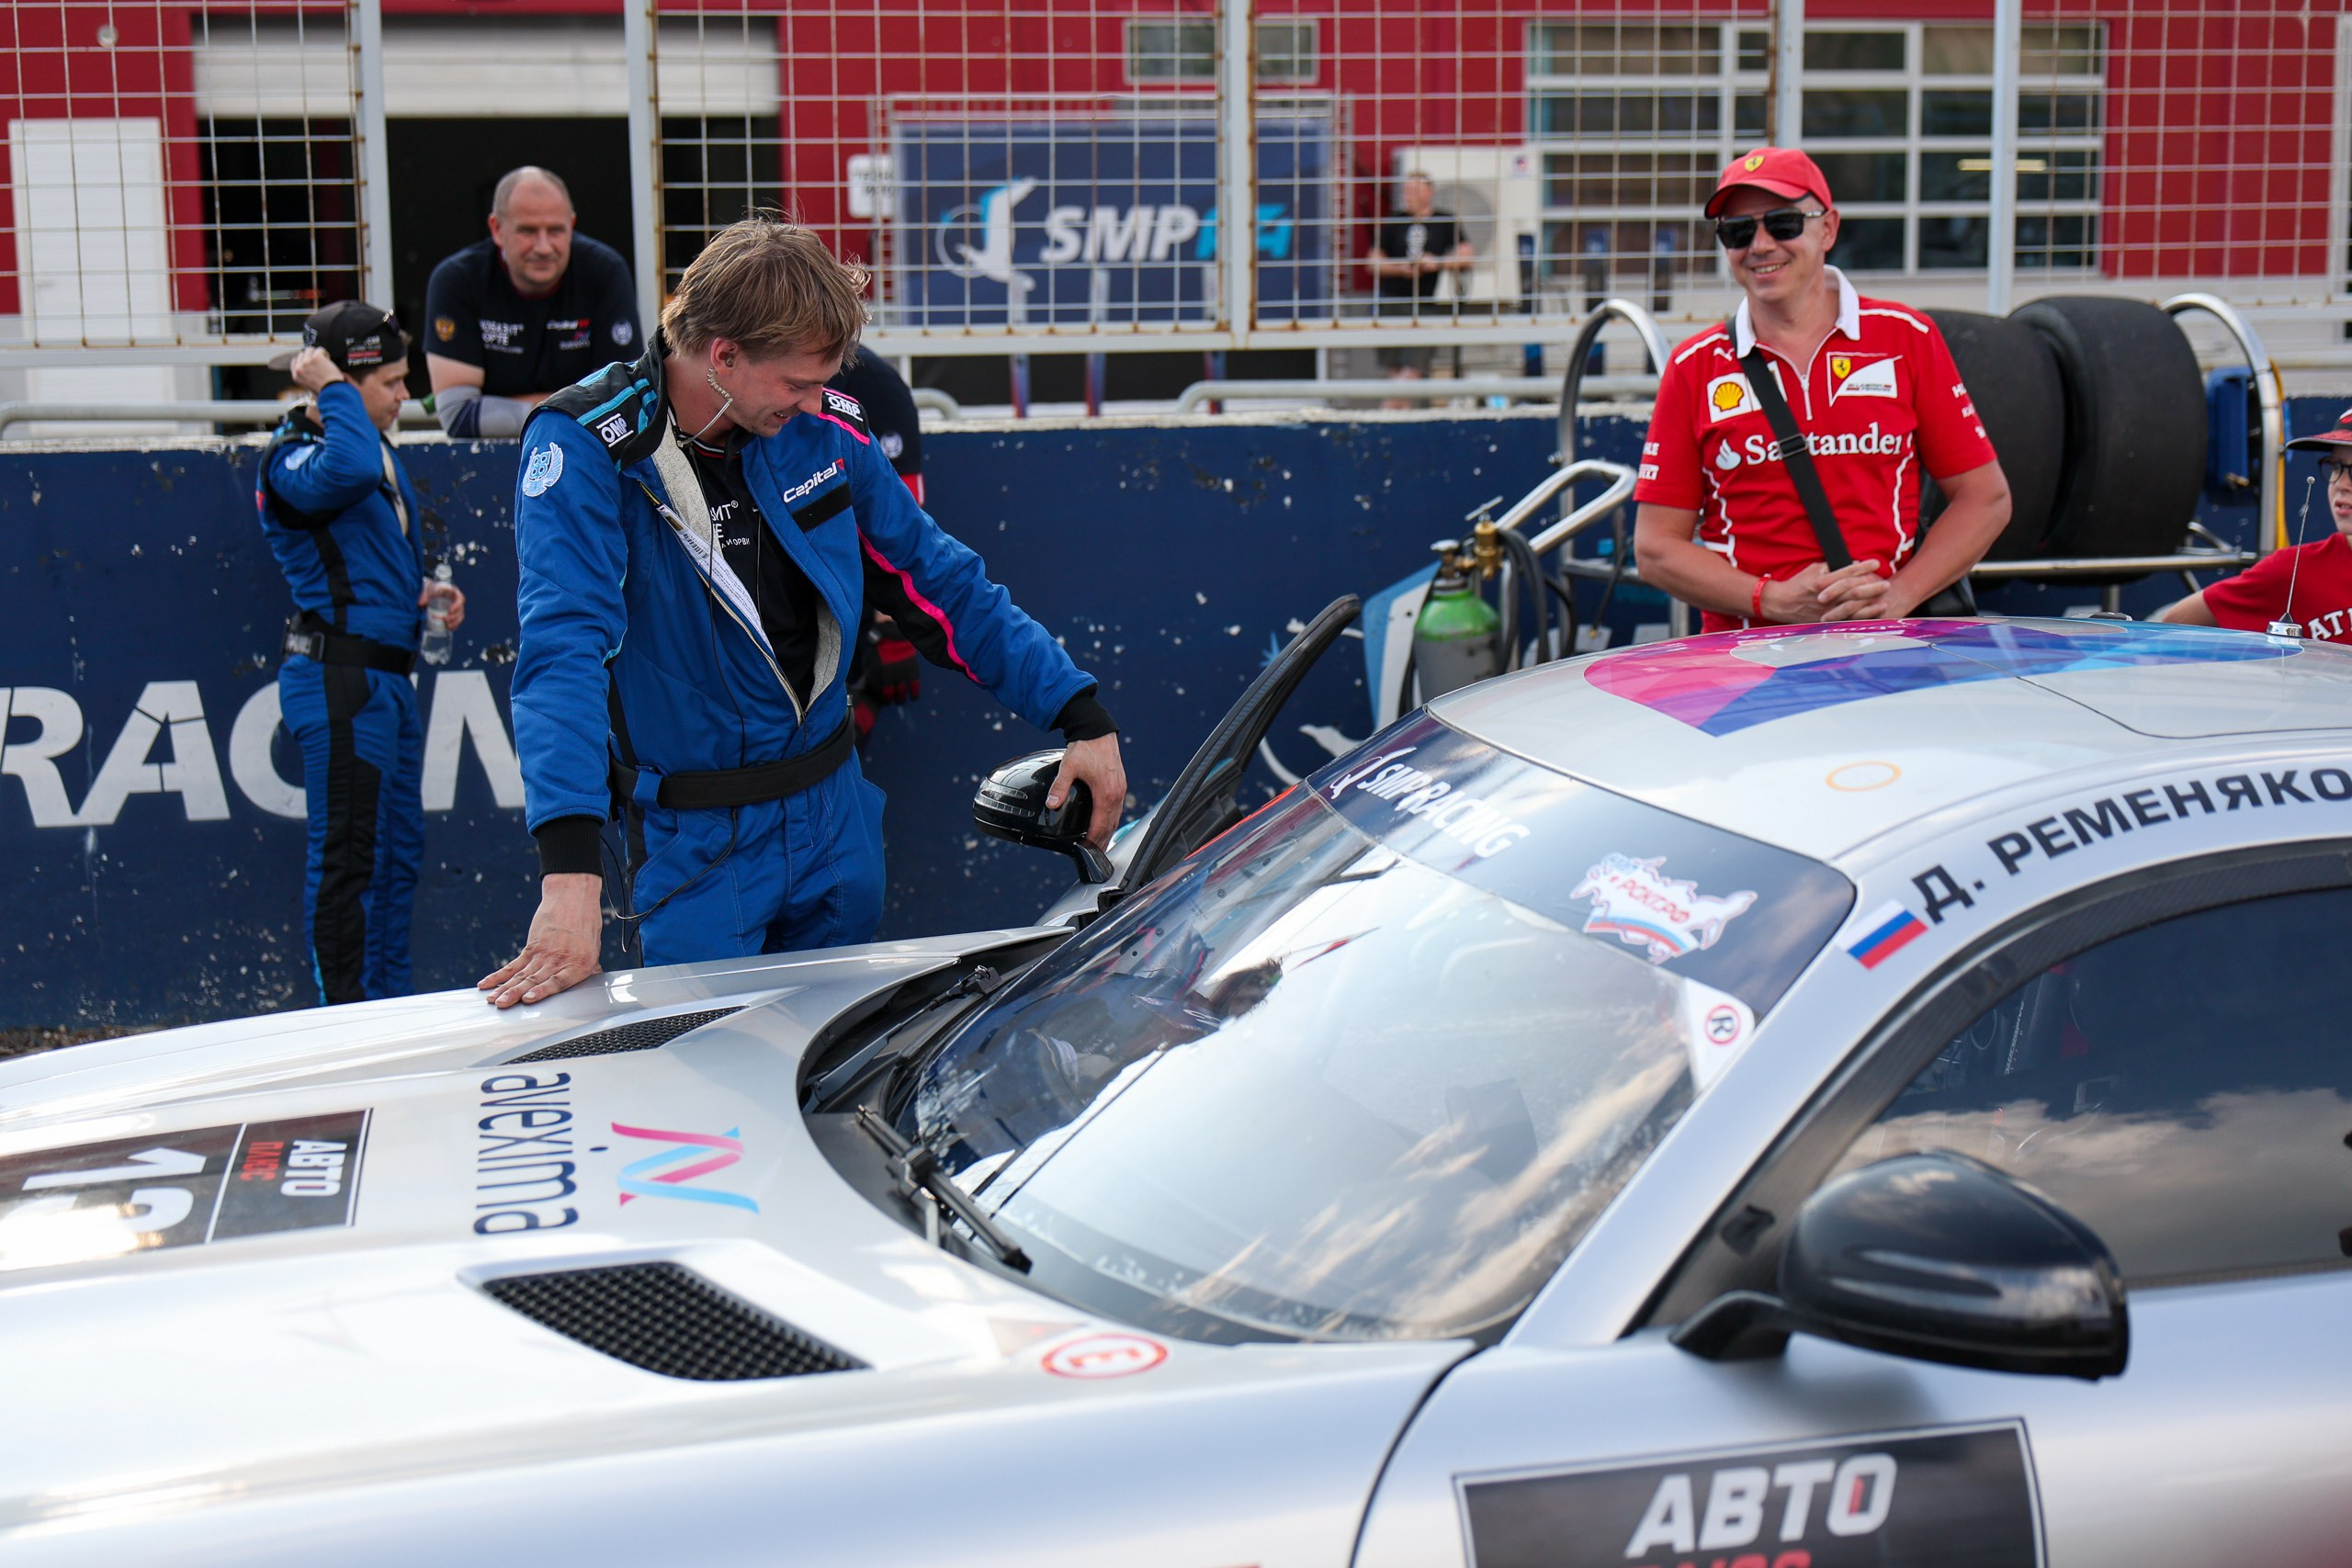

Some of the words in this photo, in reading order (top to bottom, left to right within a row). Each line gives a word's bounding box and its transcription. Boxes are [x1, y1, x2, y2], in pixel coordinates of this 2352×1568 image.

[1039, 204, 1200, 264] SMP
[601, 417, 628, 443] OMP
[828, 396, 862, 417] OMP
[783, 461, 839, 503] Capital
[1911, 864, 1984, 925] Д.
[1986, 767, 2352, 875] РЕМЕНЯКО
[240, 1140, 285, 1183] ПЛЮС
[280, 1139, 348, 1197] АВТО
[474, 1072, 608, 1235] avexima
[1623, 1454, 1898, 1559] АВТО
